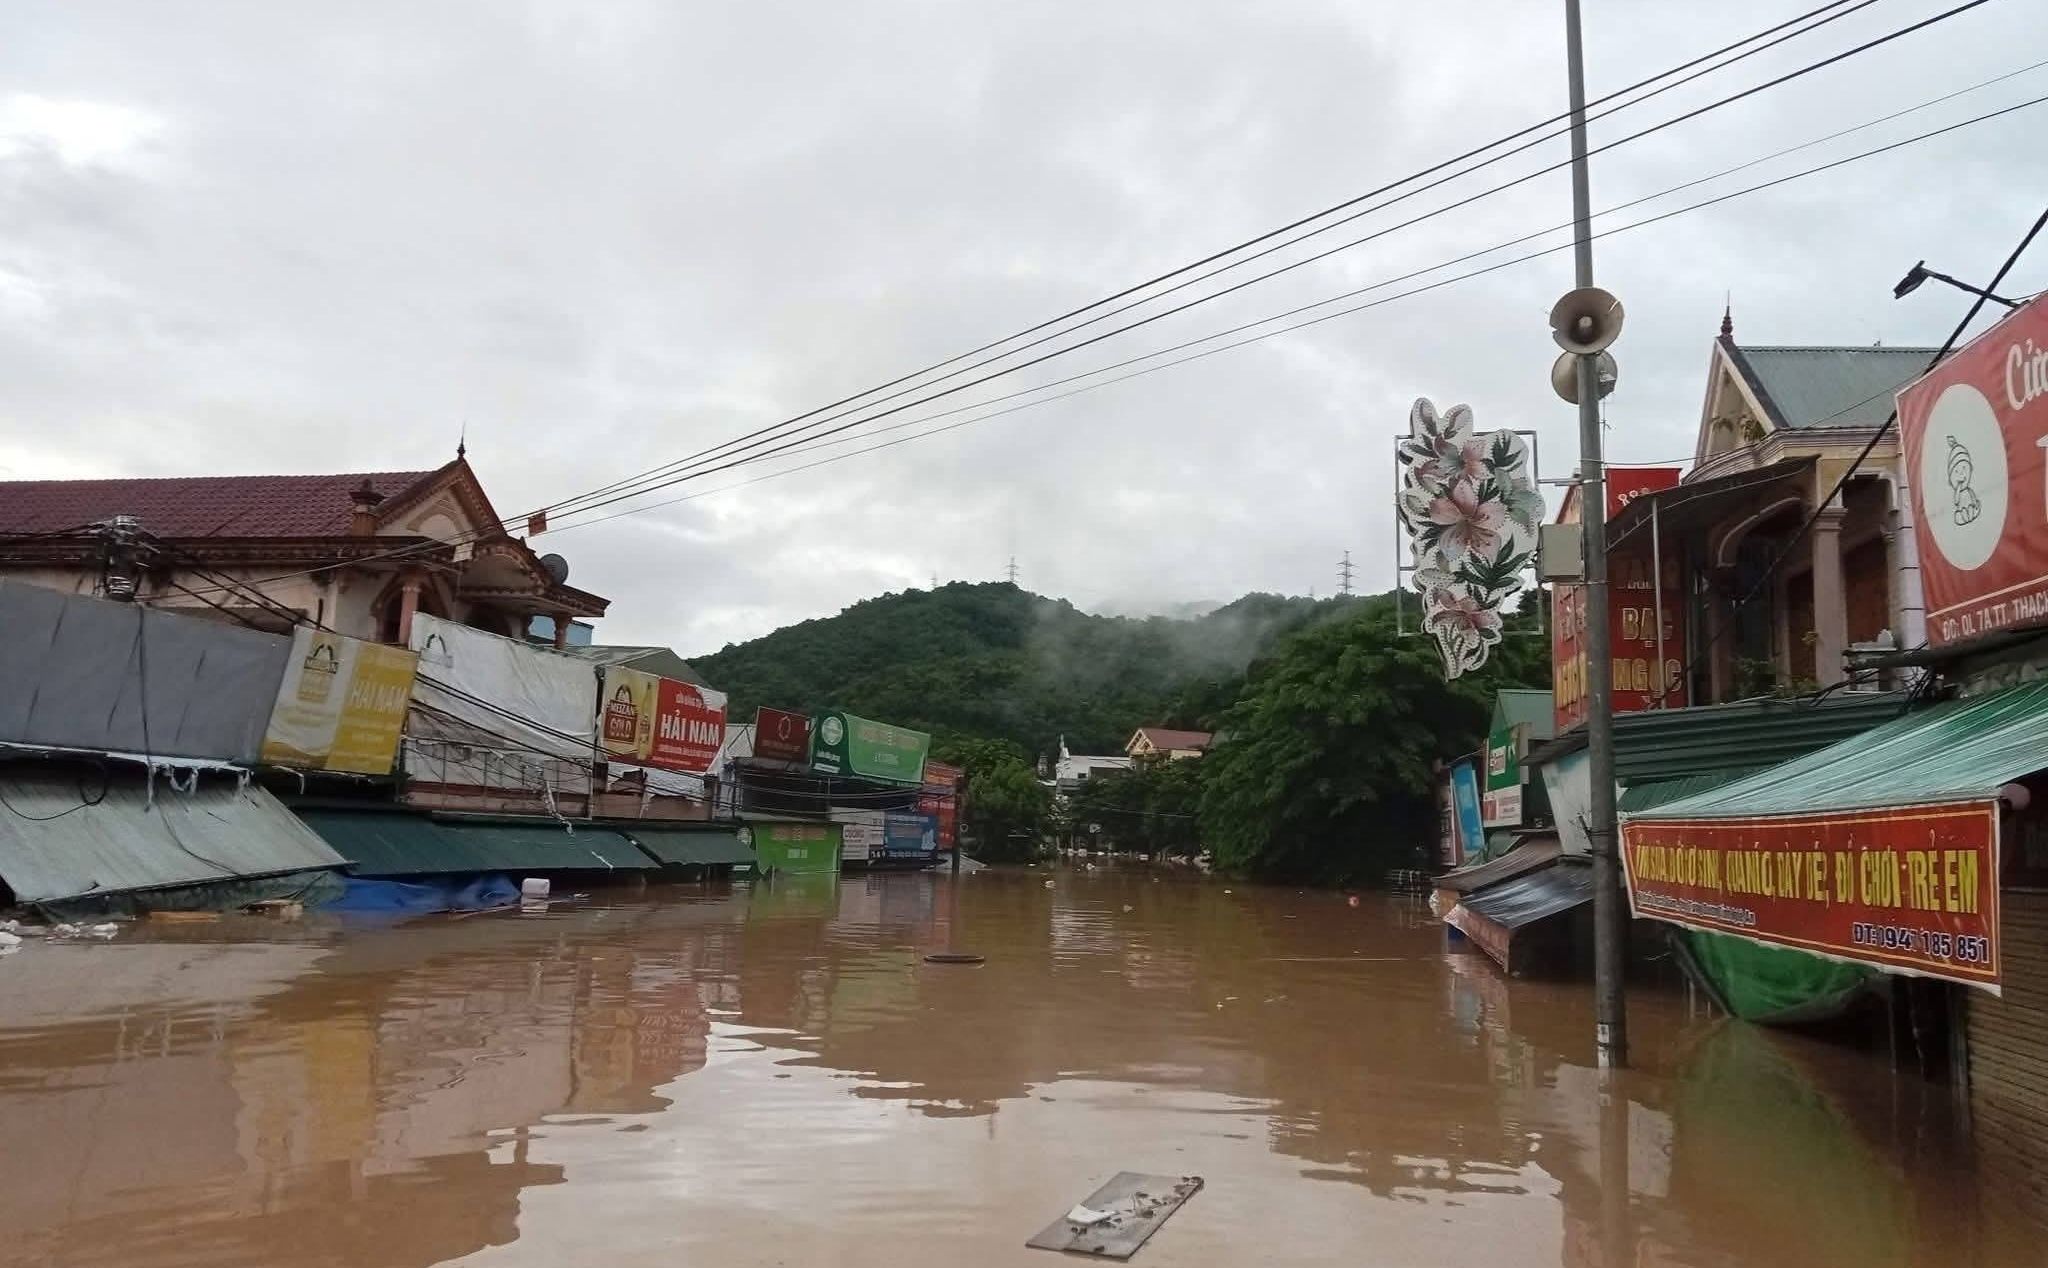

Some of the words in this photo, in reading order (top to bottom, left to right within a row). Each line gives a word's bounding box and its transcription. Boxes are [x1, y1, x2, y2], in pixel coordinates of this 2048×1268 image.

[1961, 613, 1977, 635] QL
[660, 709, 687, 740] HẢI
[688, 719, 720, 747] NAM
[1907, 829, 1941, 911] TRẺ
[1944, 850, 1979, 914] EM
[1920, 930, 1952, 958] 185
[1955, 935, 1990, 964] 851
